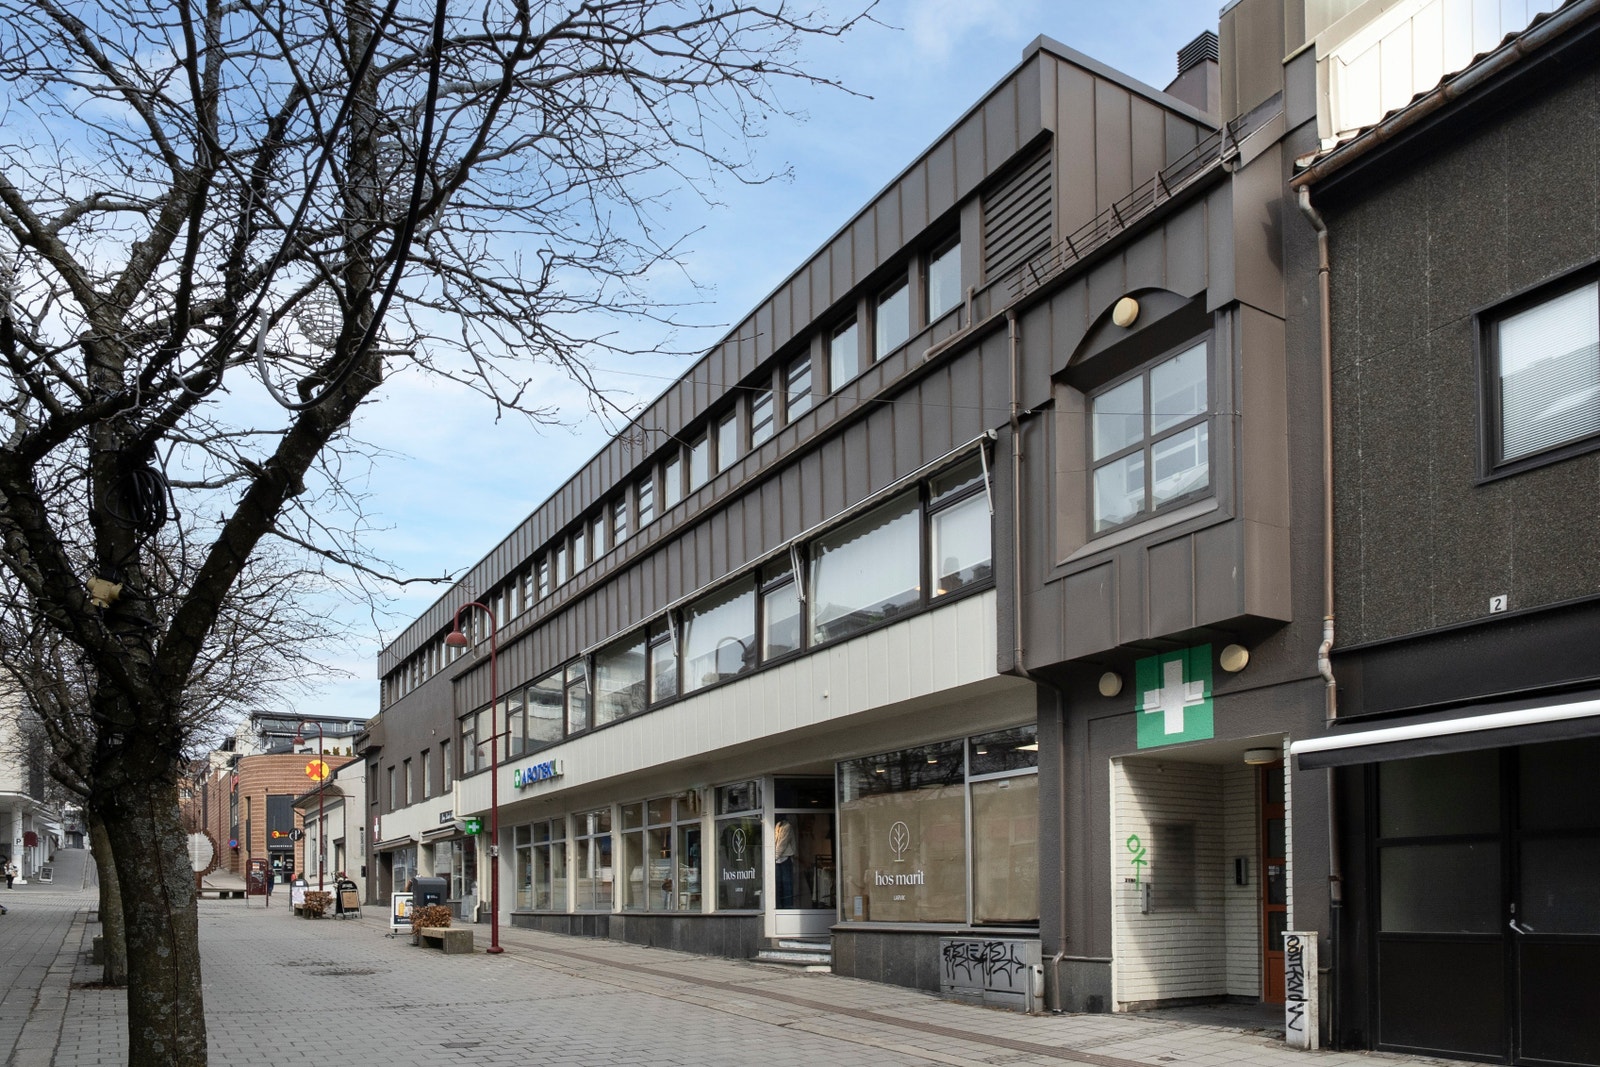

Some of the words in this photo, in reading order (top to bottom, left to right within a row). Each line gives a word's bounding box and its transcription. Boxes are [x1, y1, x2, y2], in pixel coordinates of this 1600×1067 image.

[1495, 598, 1501, 611] 2
[522, 760, 553, 785] APOTEK
[723, 868, 736, 880] hos
[737, 867, 756, 879] marit
[875, 870, 894, 886] hos
[896, 869, 925, 885] marit
